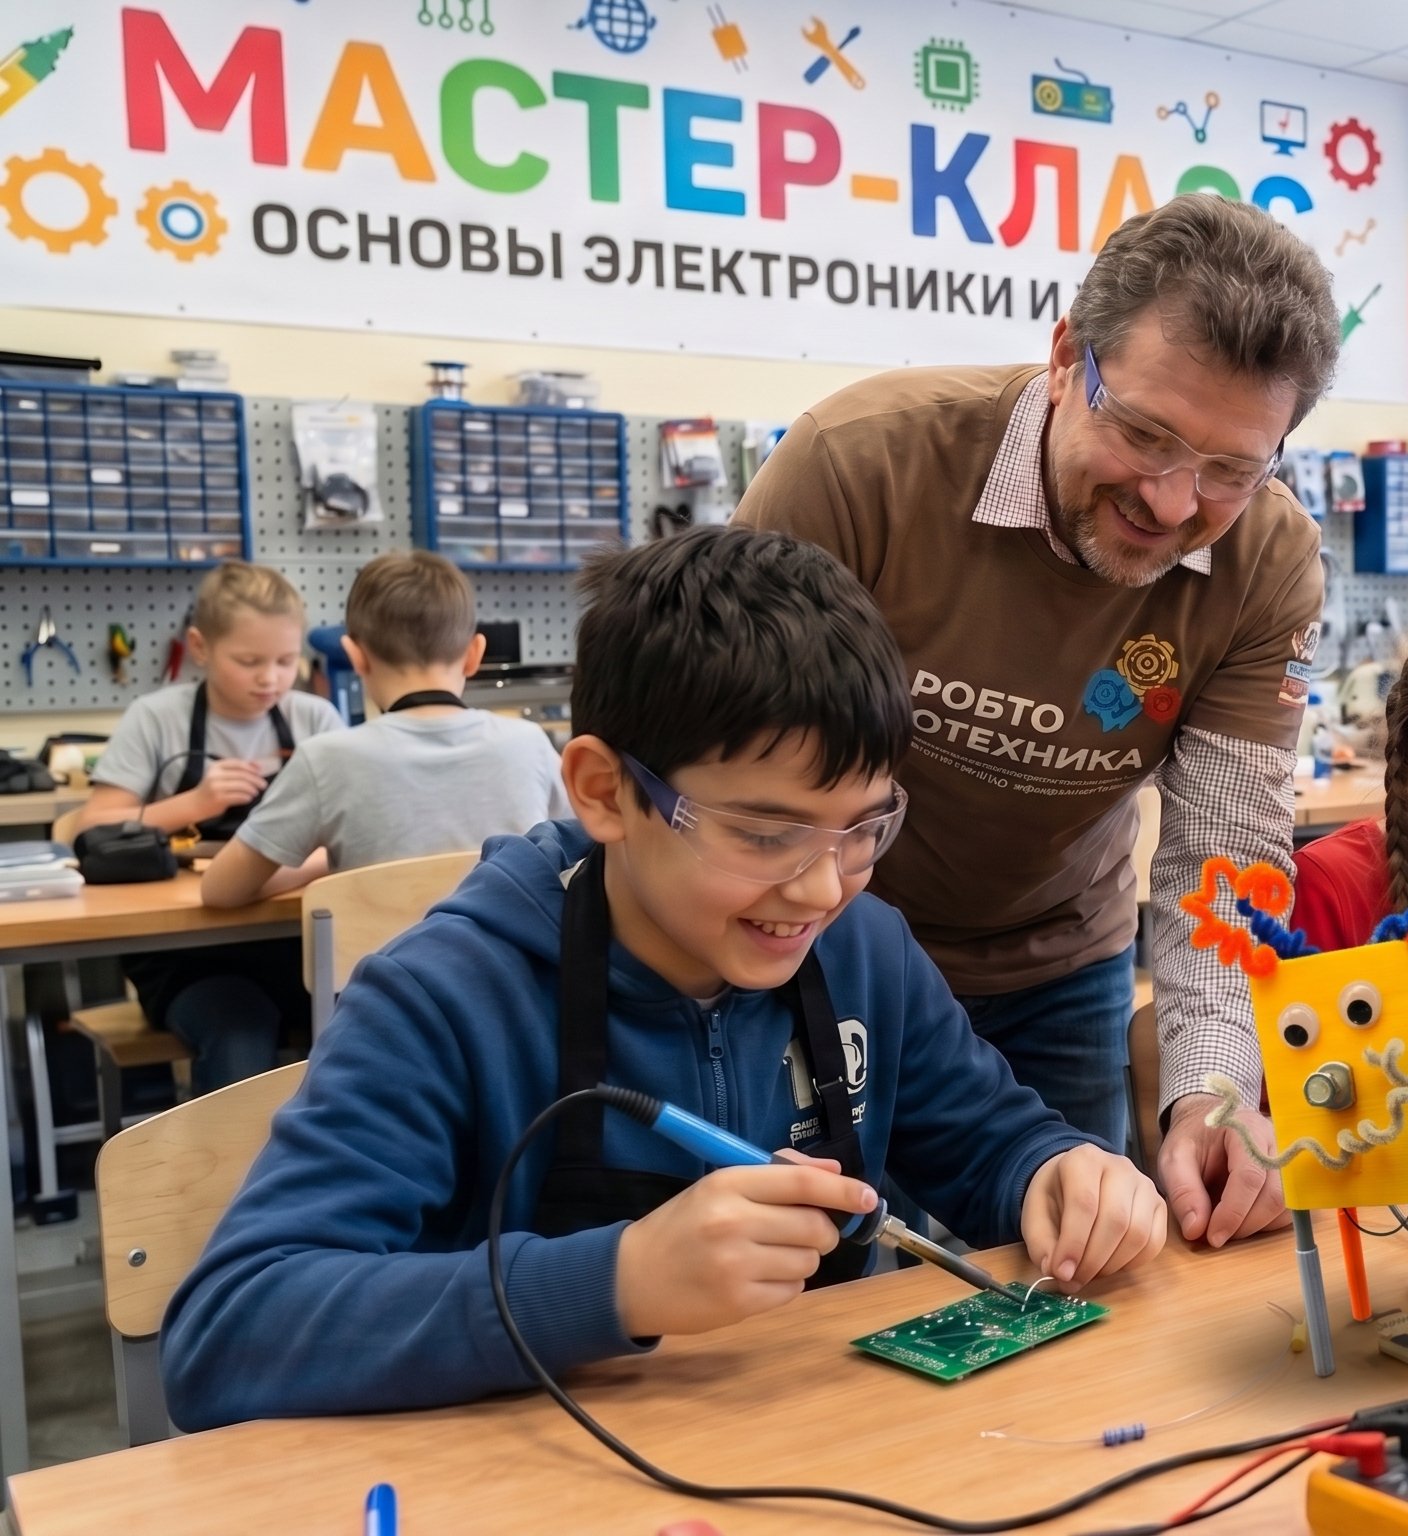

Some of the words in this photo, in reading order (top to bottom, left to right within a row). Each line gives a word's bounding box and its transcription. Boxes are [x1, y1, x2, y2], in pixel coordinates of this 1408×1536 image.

[252, 203, 563, 280] ОСНОВЫ
[583, 235, 1012, 318] ЭЛЕКТРОНИКИ
[1030, 280, 1058, 321] И
[910, 670, 1064, 733] РОБТО
[912, 709, 1143, 771] ОТЕХНИКА
